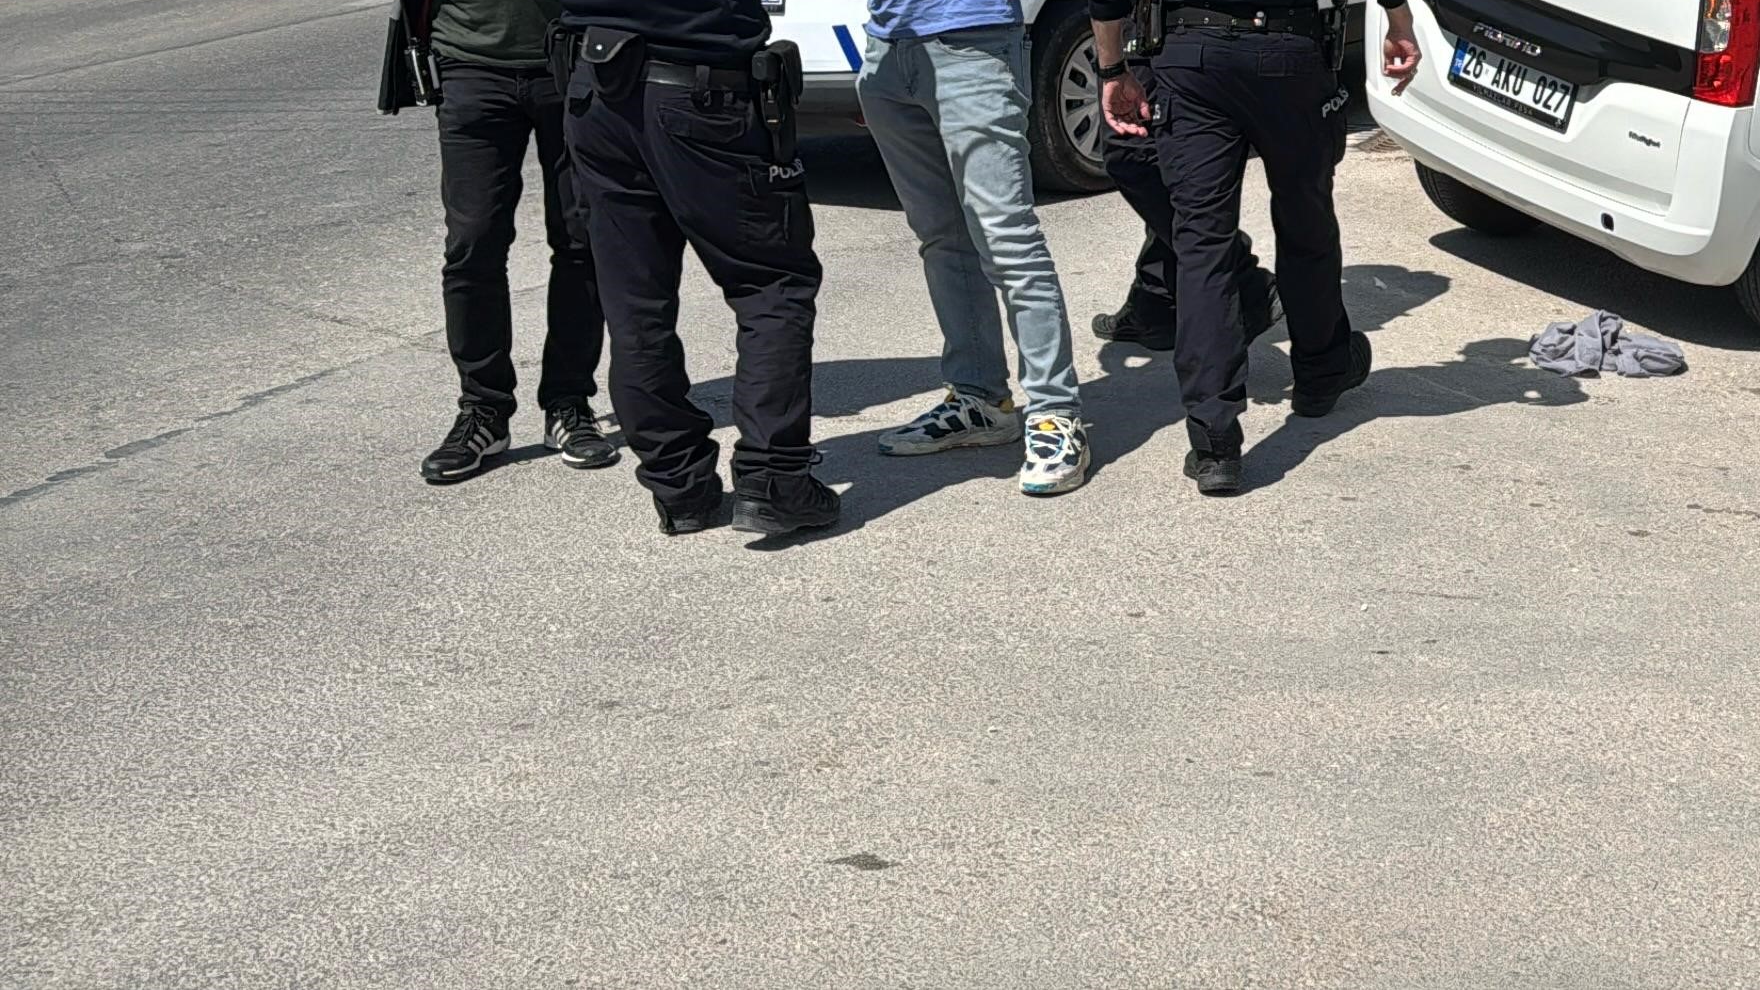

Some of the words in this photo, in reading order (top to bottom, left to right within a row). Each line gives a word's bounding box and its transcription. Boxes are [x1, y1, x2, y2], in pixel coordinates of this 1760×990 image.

[1462, 46, 1487, 79] 26
[1491, 58, 1529, 96] AKU
[1533, 75, 1572, 113] 027
